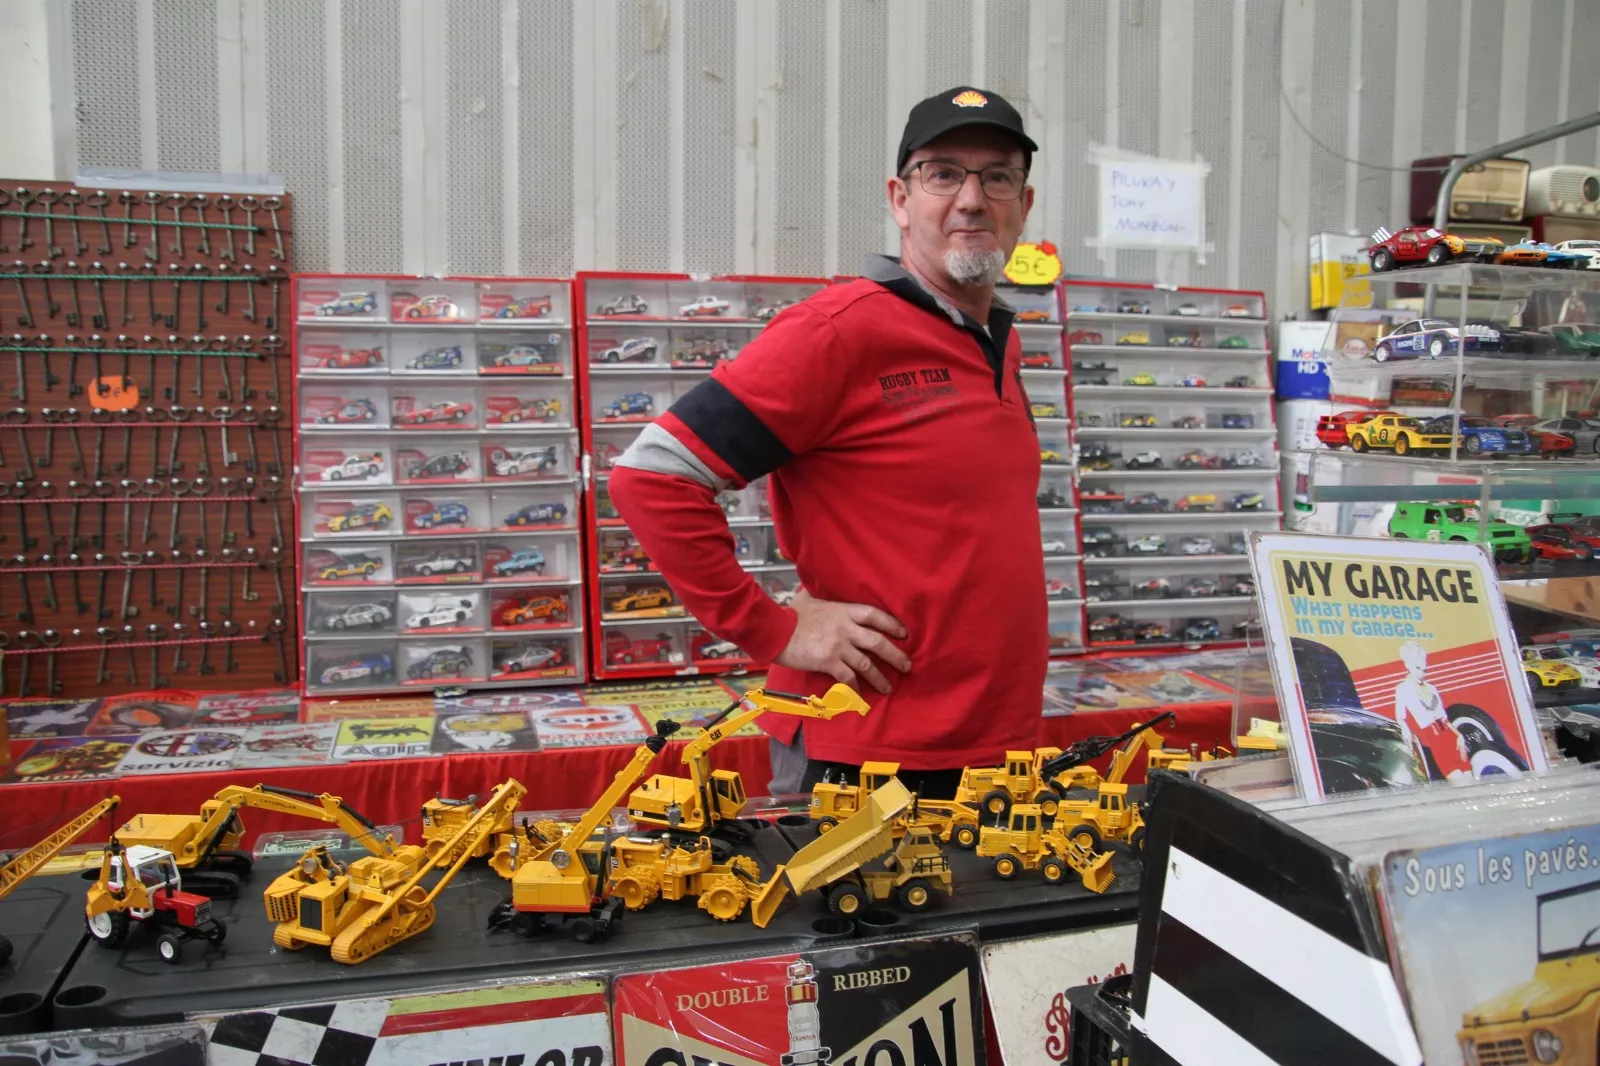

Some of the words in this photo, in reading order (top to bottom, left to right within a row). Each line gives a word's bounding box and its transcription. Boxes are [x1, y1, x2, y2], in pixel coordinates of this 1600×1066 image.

[1297, 360, 1320, 375] HD
[878, 371, 917, 391] RUGBY
[920, 368, 952, 384] TEAM
[1282, 559, 1332, 597] MY
[1344, 563, 1478, 603] GARAGE
[710, 729, 723, 742] CAT
[342, 742, 428, 758] Agip
[121, 759, 230, 771] servizio
[1404, 856, 1465, 897] Sous
[1477, 847, 1513, 885] les
[676, 985, 770, 1012] DOUBLE
[832, 966, 912, 991] RIBBED
